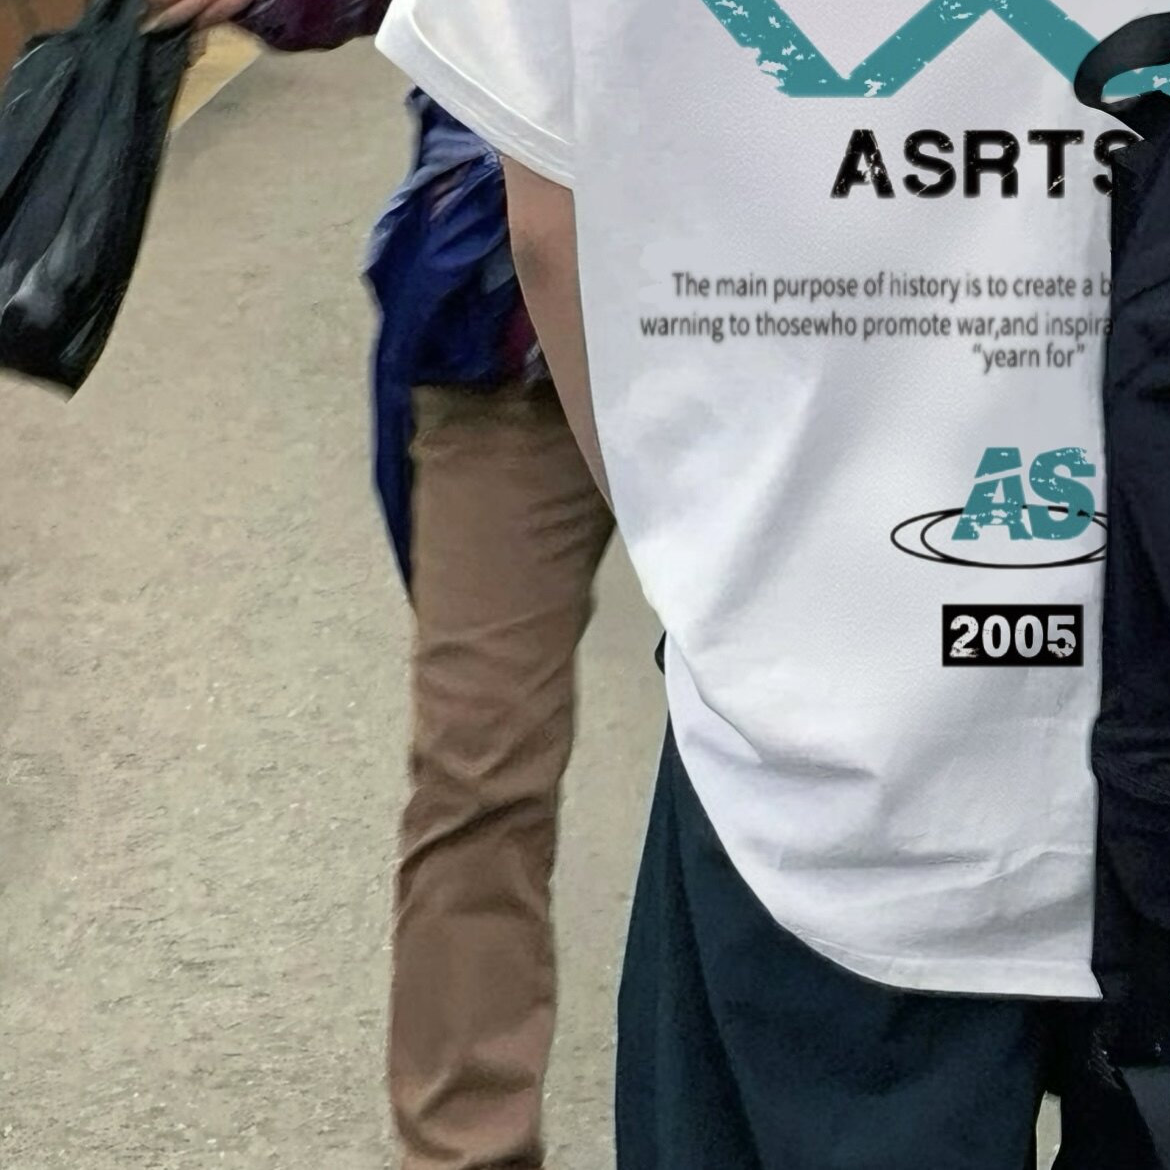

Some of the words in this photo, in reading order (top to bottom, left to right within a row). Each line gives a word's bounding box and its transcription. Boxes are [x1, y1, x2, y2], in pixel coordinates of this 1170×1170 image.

[672, 271, 711, 298] The
[716, 273, 767, 298] main
[773, 277, 859, 304] purpose
[863, 271, 885, 298] of
[890, 272, 961, 304] history
[966, 273, 982, 298] is
[987, 275, 1007, 298] to
[1013, 275, 1076, 298] create
[1082, 278, 1093, 298] a
[640, 312, 725, 344] warning
[729, 314, 750, 337] to
[755, 311, 858, 337] thosewho
[863, 314, 951, 343] promote
[951, 446, 1096, 541] AS
[949, 614, 1077, 658] 2005
